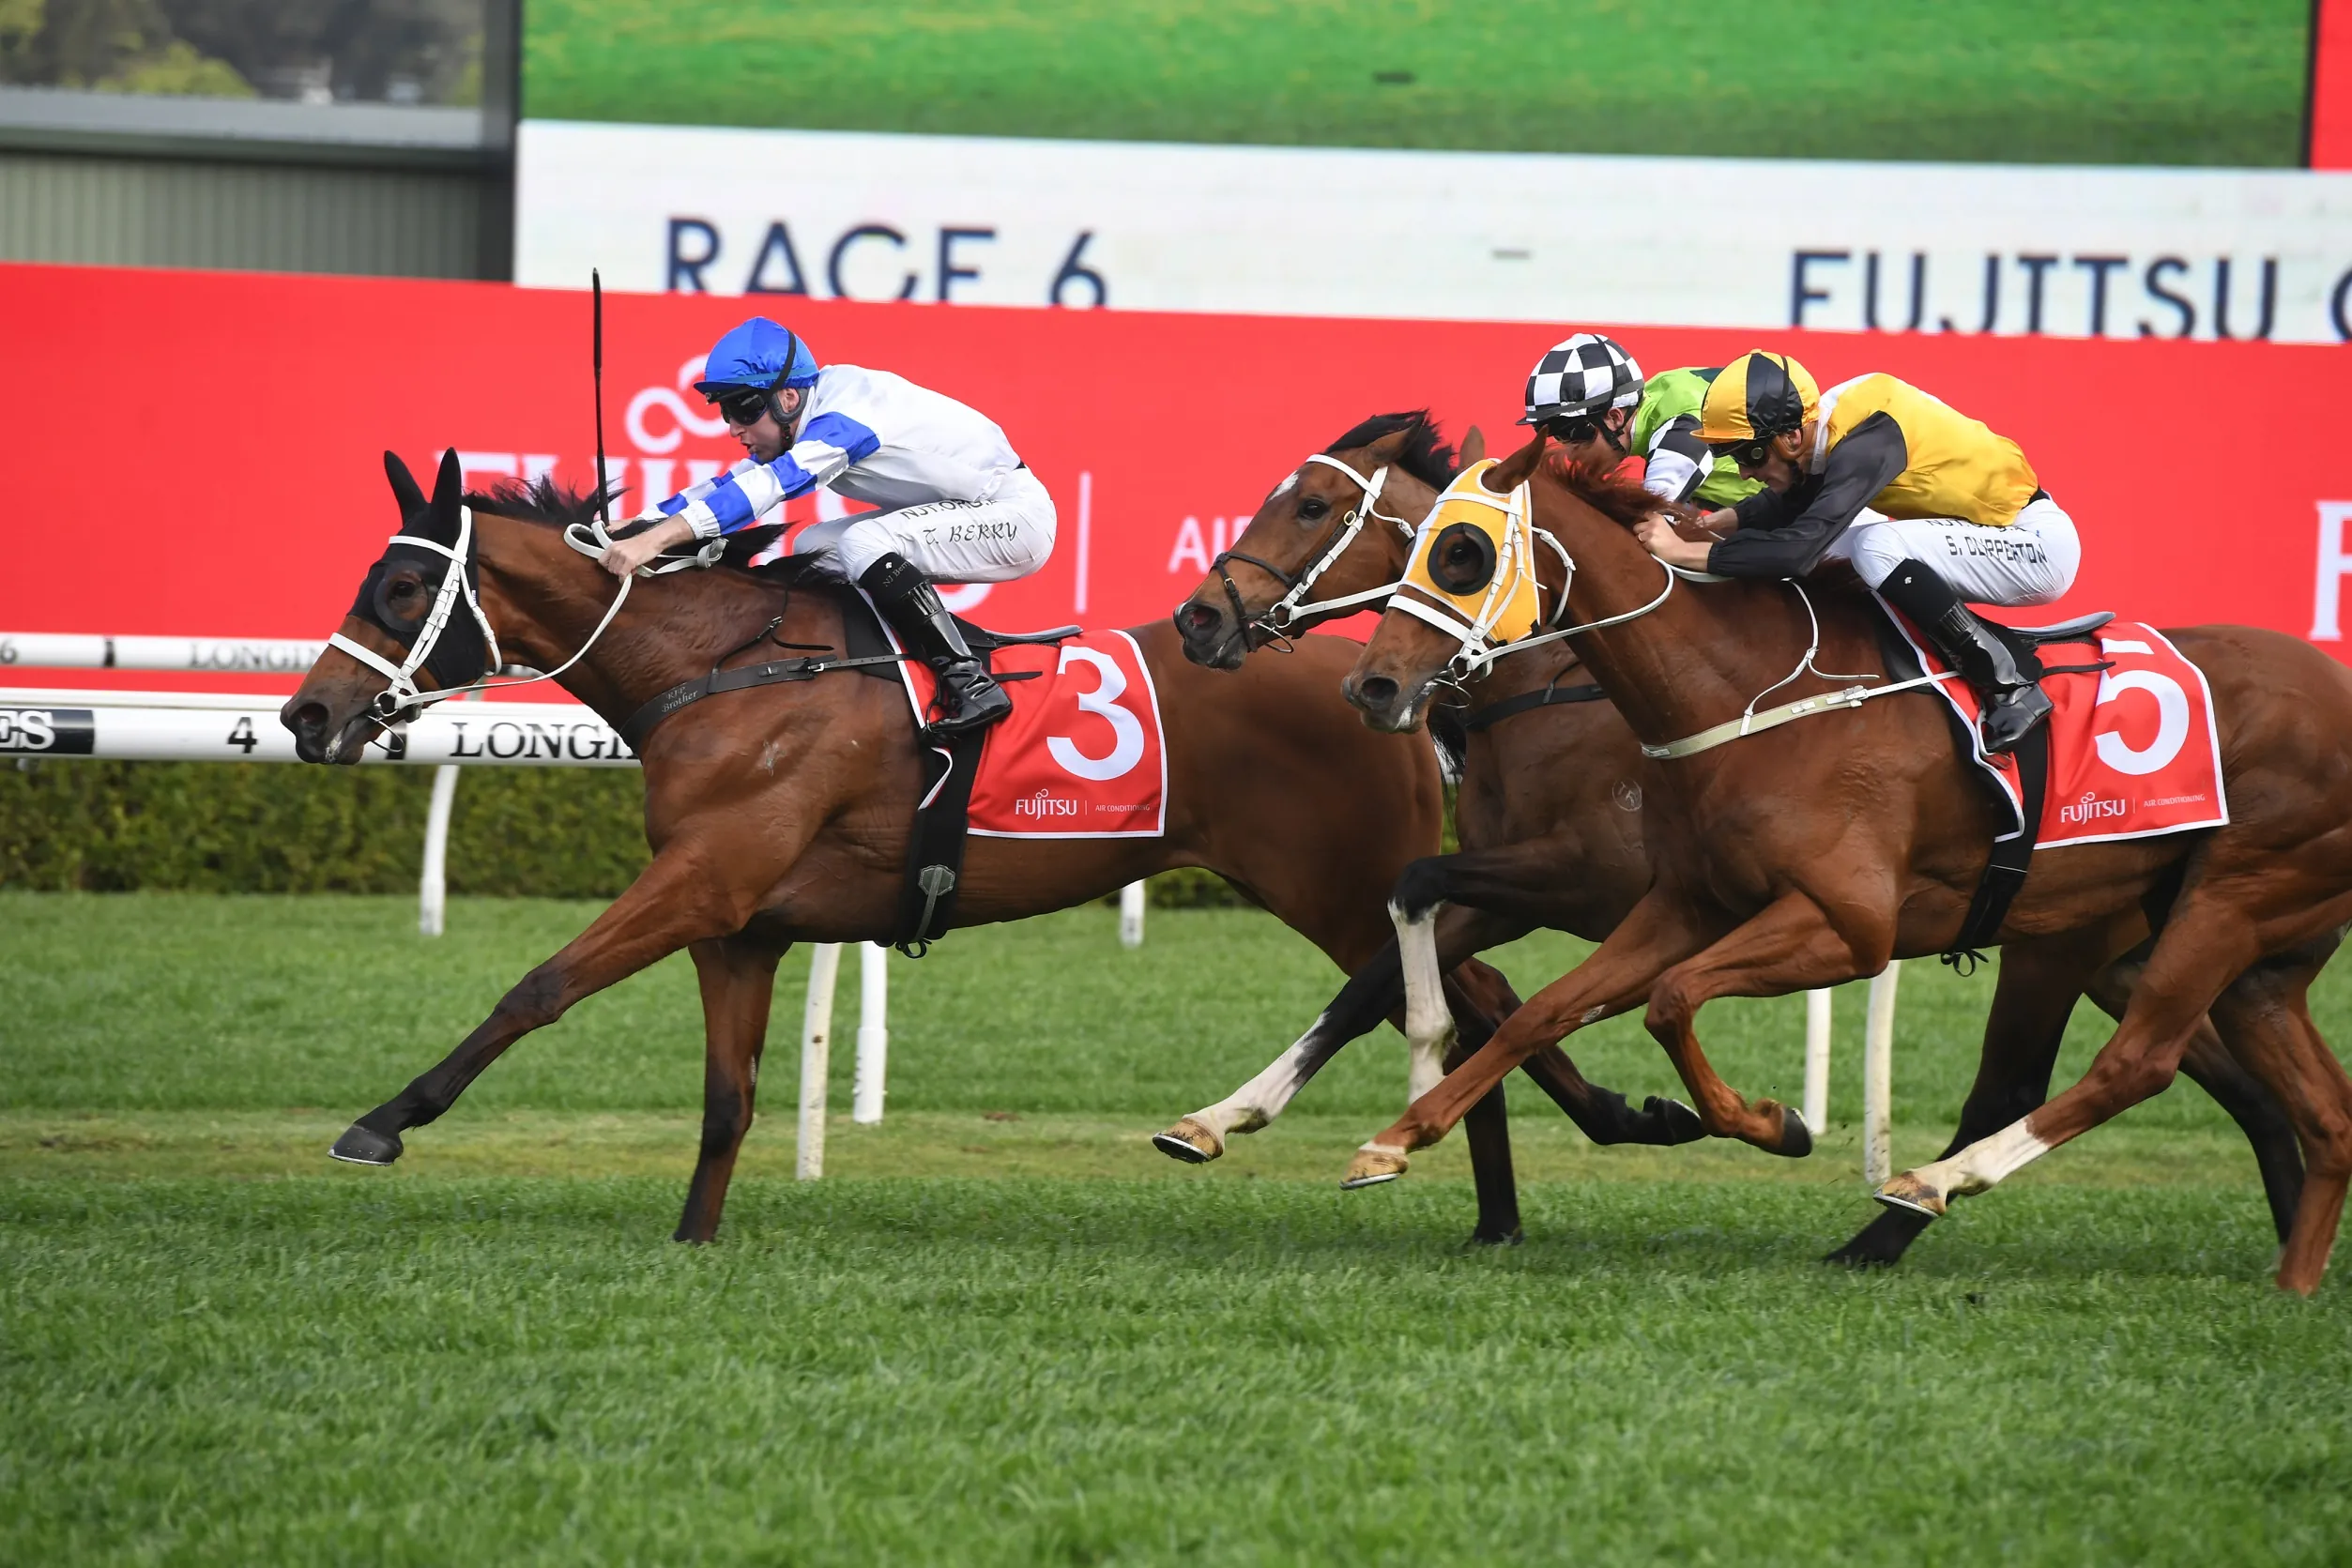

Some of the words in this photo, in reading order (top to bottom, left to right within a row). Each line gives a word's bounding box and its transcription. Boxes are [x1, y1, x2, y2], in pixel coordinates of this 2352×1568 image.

[1050, 230, 1107, 308] 6
[1792, 250, 2279, 340] FUJITSU
[949, 522, 1017, 542] BERRY
[661, 691, 698, 712] Brother
[1046, 646, 1144, 781] 3
[2094, 638, 2190, 775] 5
[227, 716, 258, 754] 4
[451, 722, 639, 760] LONGI
[1015, 798, 1077, 821] FUJITSU
[2060, 798, 2126, 825] FUJITSU
[2143, 799, 2158, 808] AIR
